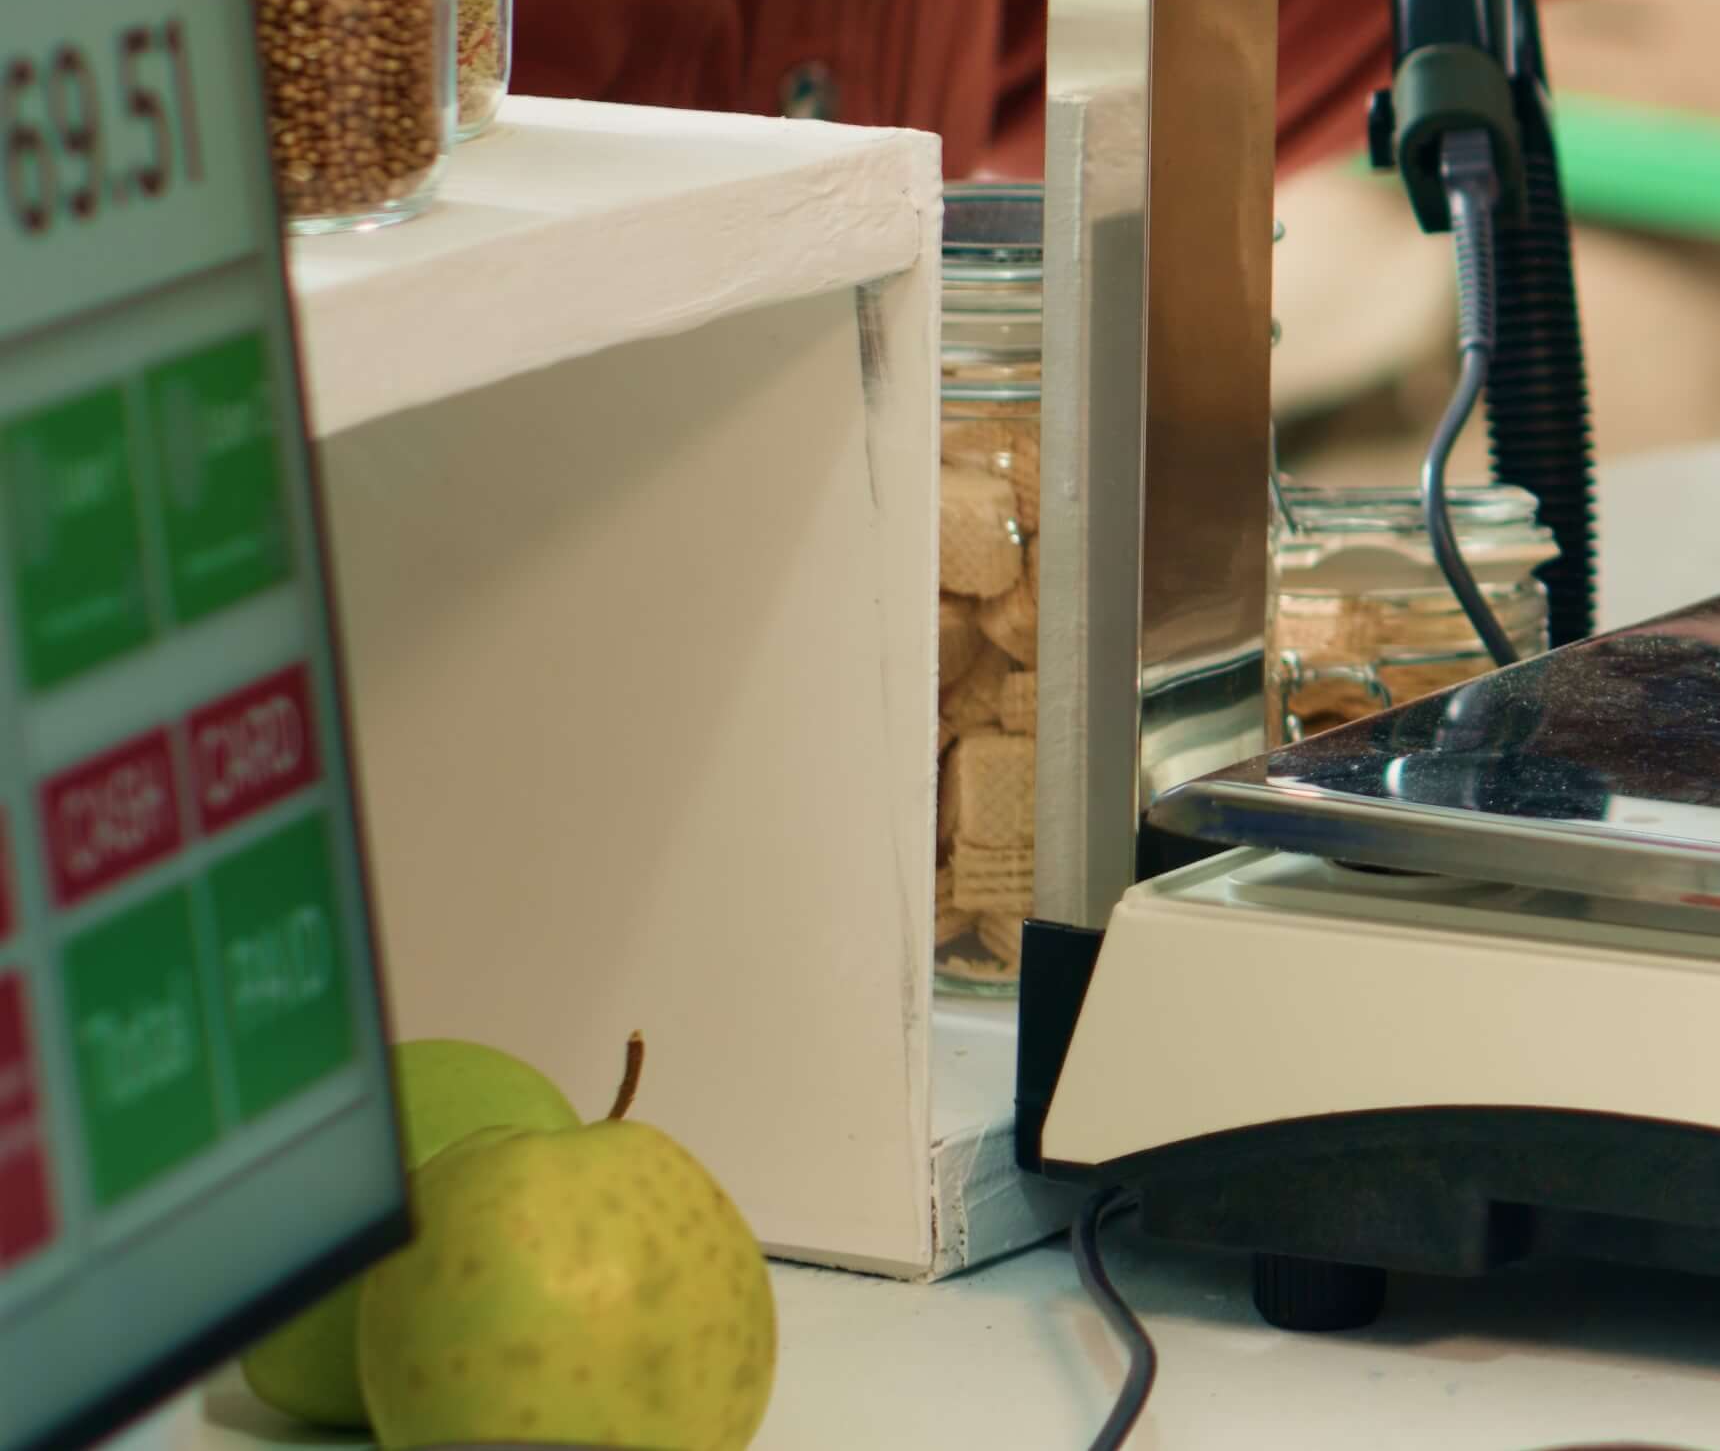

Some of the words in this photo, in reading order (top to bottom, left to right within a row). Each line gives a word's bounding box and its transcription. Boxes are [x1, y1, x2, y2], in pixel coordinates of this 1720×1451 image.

[1, 14, 204, 237] 69.51
[60, 756, 168, 875] CASH
[199, 695, 300, 806] CARD
